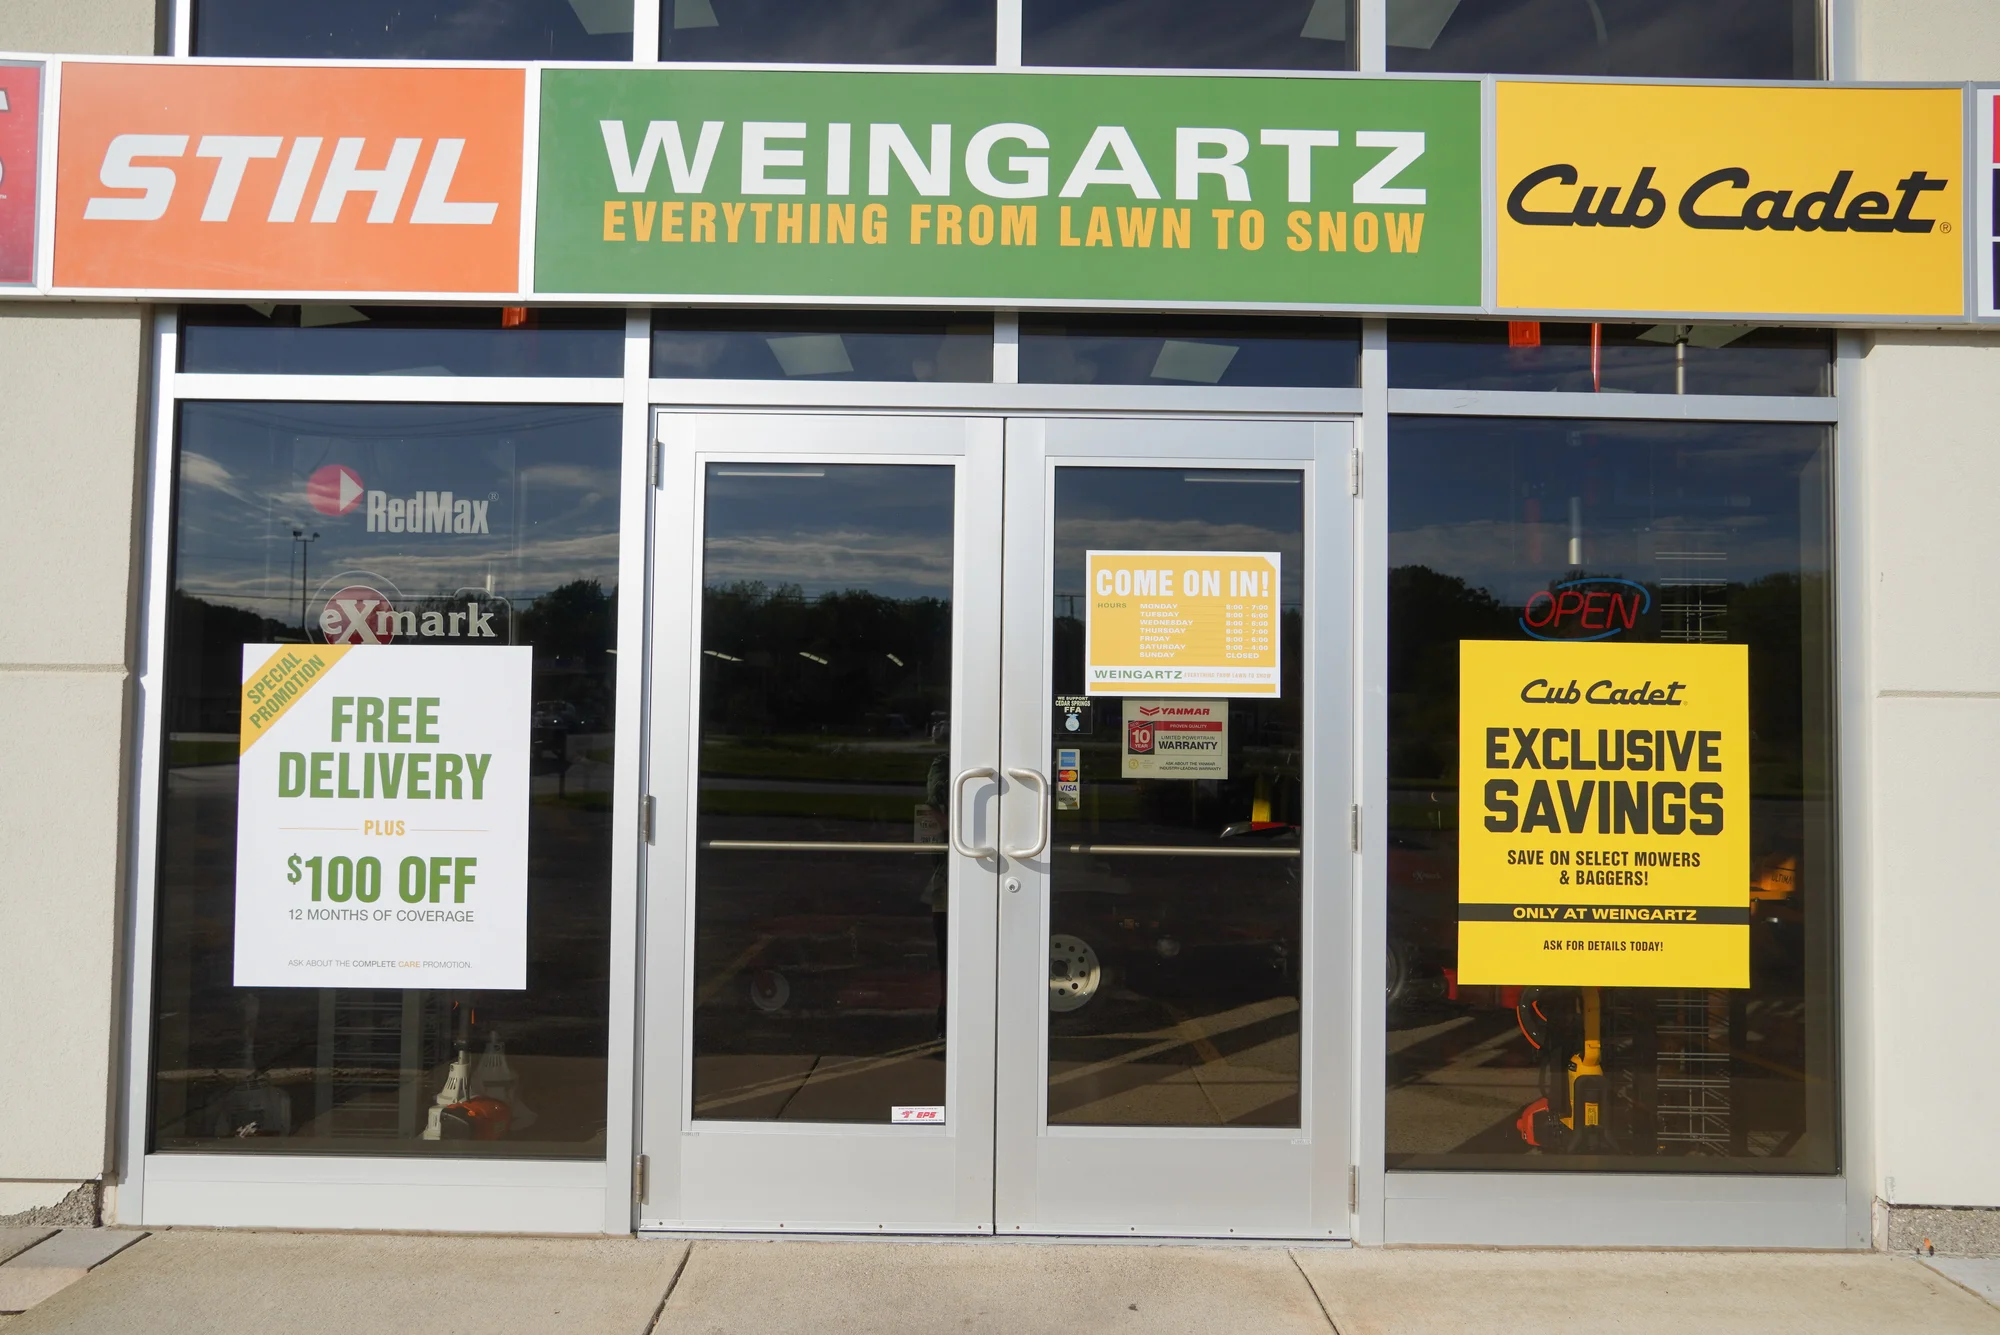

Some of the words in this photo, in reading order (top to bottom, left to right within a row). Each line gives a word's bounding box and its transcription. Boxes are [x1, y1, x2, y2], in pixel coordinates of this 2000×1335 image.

[83, 134, 499, 224] STIHL
[600, 120, 1426, 205] WEINGARTZ
[1506, 164, 1666, 228] Cub
[1678, 167, 1948, 233] Cadet
[603, 201, 887, 244] EVERYTHING
[910, 204, 1036, 246] FROM
[1060, 206, 1191, 249] LAWN
[1212, 209, 1265, 251] TO
[1286, 210, 1424, 253] SNOW
[367, 490, 489, 534] RedMax
[1096, 569, 1174, 597] COME
[1183, 570, 1220, 597] ON
[1230, 571, 1269, 597] IN!
[1525, 590, 1640, 629] OPEN
[247, 652, 302, 704] SPECIAL
[1095, 670, 1182, 679] WEINGARTZ
[249, 654, 325, 729] PROMOTION
[1521, 679, 1581, 704] Cub
[1585, 680, 1687, 706] Cadet
[331, 696, 440, 743] FREE
[1161, 707, 1210, 716] YANMAR
[1132, 729, 1151, 744] 10
[1158, 741, 1218, 750] WARRANTY
[1486, 727, 1722, 772] EXCLUSIVE
[278, 752, 492, 800] DELIVERY
[1484, 778, 1724, 836] SAVINGS
[364, 820, 405, 836] PLUS
[1507, 850, 1544, 865] SAVE
[1550, 850, 1570, 866] ON
[1576, 851, 1628, 866] SELECT
[1634, 852, 1701, 867] MOWERS
[287, 853, 381, 903] $100
[399, 856, 477, 903] OFF
[1559, 870, 1570, 885] &
[1576, 870, 1649, 886] BAGGERS!
[289, 909, 303, 921] 12
[308, 909, 368, 921] MONTHS
[373, 909, 392, 921] OF
[396, 910, 474, 922] COVERAGE
[1513, 907, 1559, 919] ONLY
[1563, 908, 1587, 919] AT
[1592, 908, 1697, 921] WEINGARTZ
[1543, 940, 1563, 950] ASK
[1566, 940, 1584, 951] FOR
[1588, 941, 1627, 951] DETAILS
[1630, 941, 1663, 952] TODAY!
[288, 959, 304, 967] ASK
[306, 959, 333, 967] ABOUT
[352, 960, 396, 968] COMPLETE
[422, 961, 473, 969] PROMOTION.
